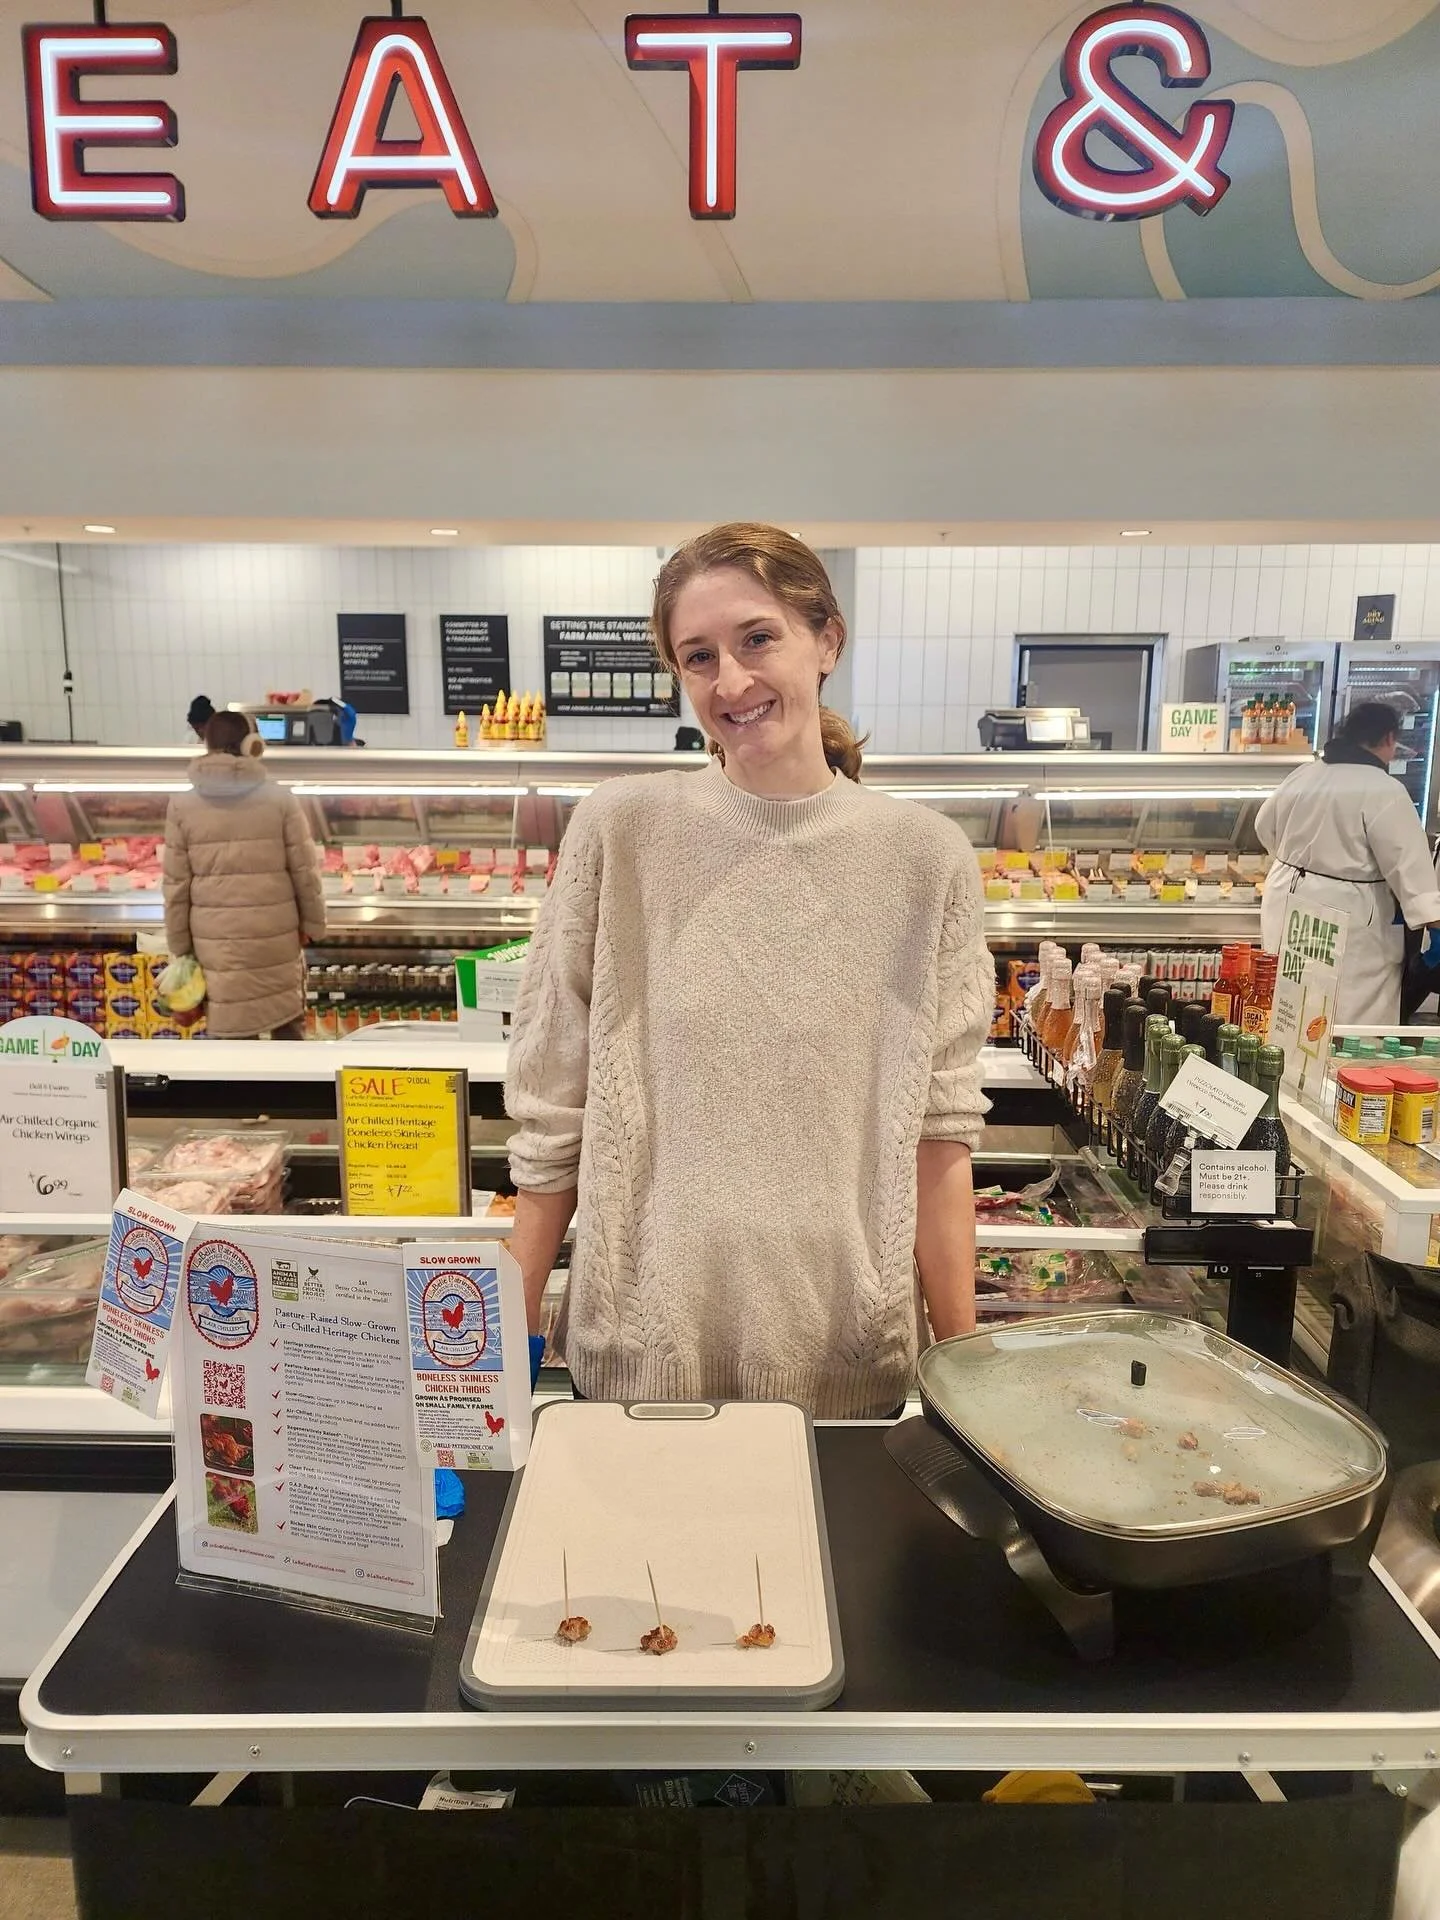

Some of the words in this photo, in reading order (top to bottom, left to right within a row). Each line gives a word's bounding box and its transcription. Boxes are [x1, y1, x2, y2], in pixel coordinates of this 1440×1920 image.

[22, 14, 803, 222] EAT
[1033, 2, 1234, 222] &
[588, 621, 605, 630] THE
[560, 632, 585, 641] FARM
[586, 632, 622, 641] ANIMAL
[1171, 709, 1218, 725] GAME
[1170, 726, 1192, 737] DAY
[1288, 909, 1339, 967] GAME
[1282, 950, 1306, 985] DAY
[1244, 1013, 1262, 1021] LOCAL
[72, 1041, 101, 1057] DAY
[349, 1077, 406, 1096] SALE
[16, 1115, 53, 1126] Chilled
[55, 1117, 99, 1129] Organic
[346, 1116, 358, 1124] Air
[361, 1116, 393, 1126] Chilled
[395, 1118, 436, 1128] Heritage
[12, 1128, 54, 1140] Chicken
[55, 1130, 91, 1143] Wings
[347, 1128, 392, 1137] Boneless
[394, 1129, 435, 1138] Skinless
[386, 1141, 418, 1150] Breast
[1199, 1163, 1235, 1171] Contains
[1237, 1164, 1269, 1172] alcohol.
[128, 1206, 149, 1220] SLOW
[149, 1215, 177, 1232] GROWN
[193, 1246, 216, 1268] LaBelle
[448, 1256, 481, 1264] GROWN
[374, 1289, 392, 1297] Project
[102, 1302, 133, 1323] BONELESS
[134, 1318, 165, 1338] SKINLESS
[275, 1308, 338, 1324] Pasture-Raised
[340, 1317, 396, 1333] Slow-Grown
[106, 1315, 132, 1333] CHICKEN
[133, 1329, 156, 1345] THIGHS
[273, 1320, 320, 1334] Air-Chilled
[323, 1326, 358, 1341] Heritage
[361, 1332, 400, 1345] Chickens
[103, 1329, 119, 1341] SMALL
[120, 1338, 138, 1350] FAMILY
[138, 1347, 155, 1359] FARMS
[416, 1373, 456, 1382] BONELESS
[459, 1374, 499, 1383] SKINLESS
[425, 1384, 459, 1393] CHICKEN
[461, 1385, 491, 1394] THIGHS
[439, 1796, 469, 1806] Nutrition
